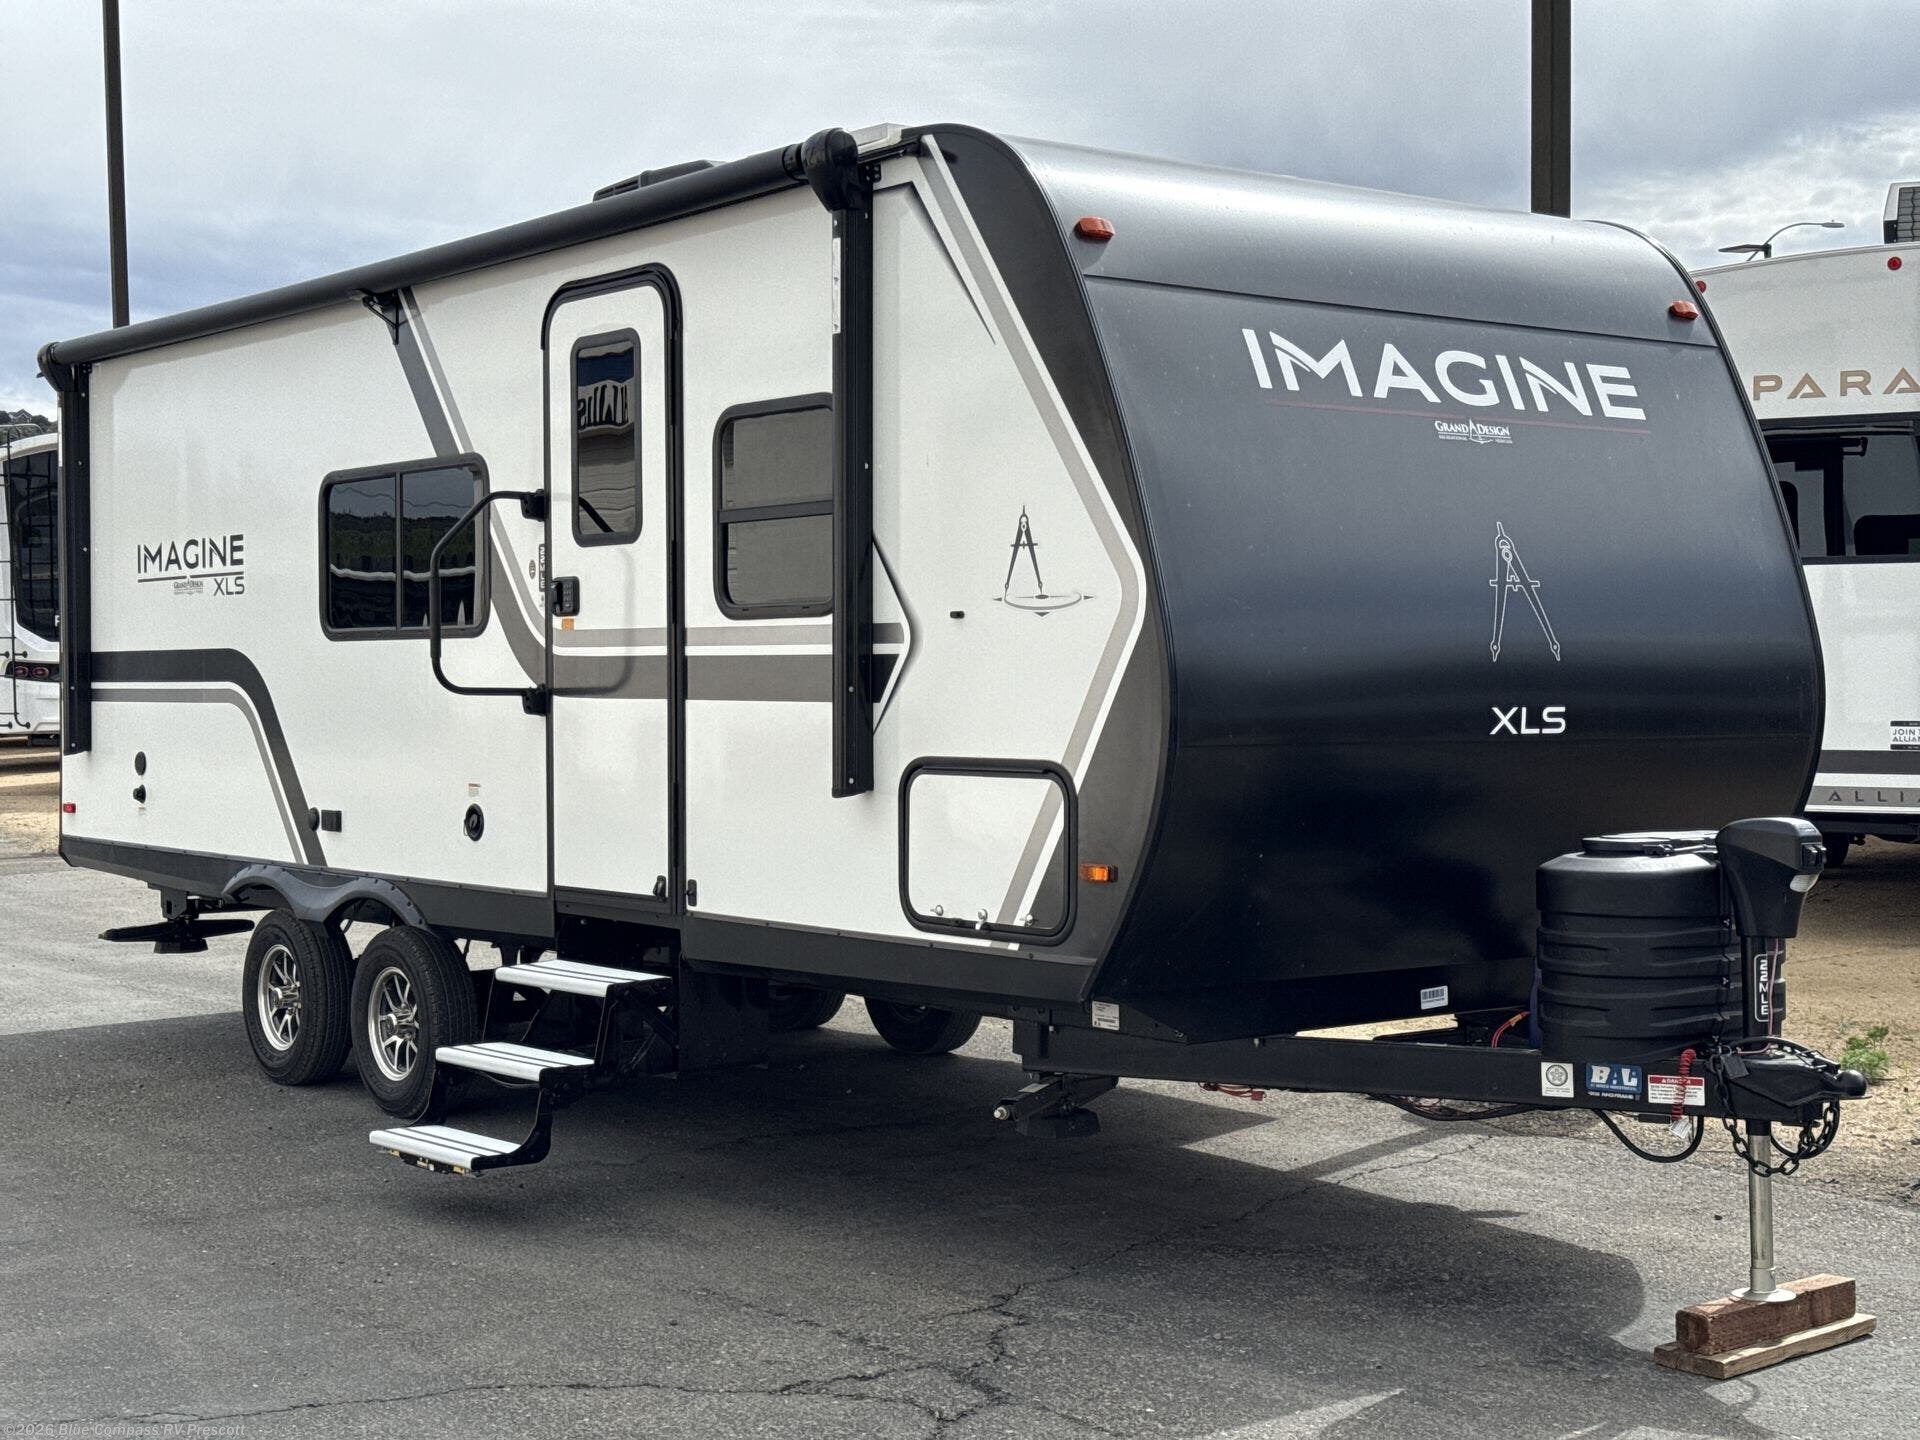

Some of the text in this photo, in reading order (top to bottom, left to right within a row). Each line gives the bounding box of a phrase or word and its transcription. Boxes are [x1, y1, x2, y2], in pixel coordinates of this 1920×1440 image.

[1242, 328, 1646, 420] IMAGINE
[1753, 367, 1920, 401] PARA
[1434, 420, 1510, 436] GRAND DESIGN
[137, 534, 244, 574] IMAGINE
[213, 576, 245, 596] XLS
[1489, 706, 1566, 735] XLS
[1892, 728, 1916, 736] JOIN
[1828, 790, 1920, 803] ALLI
